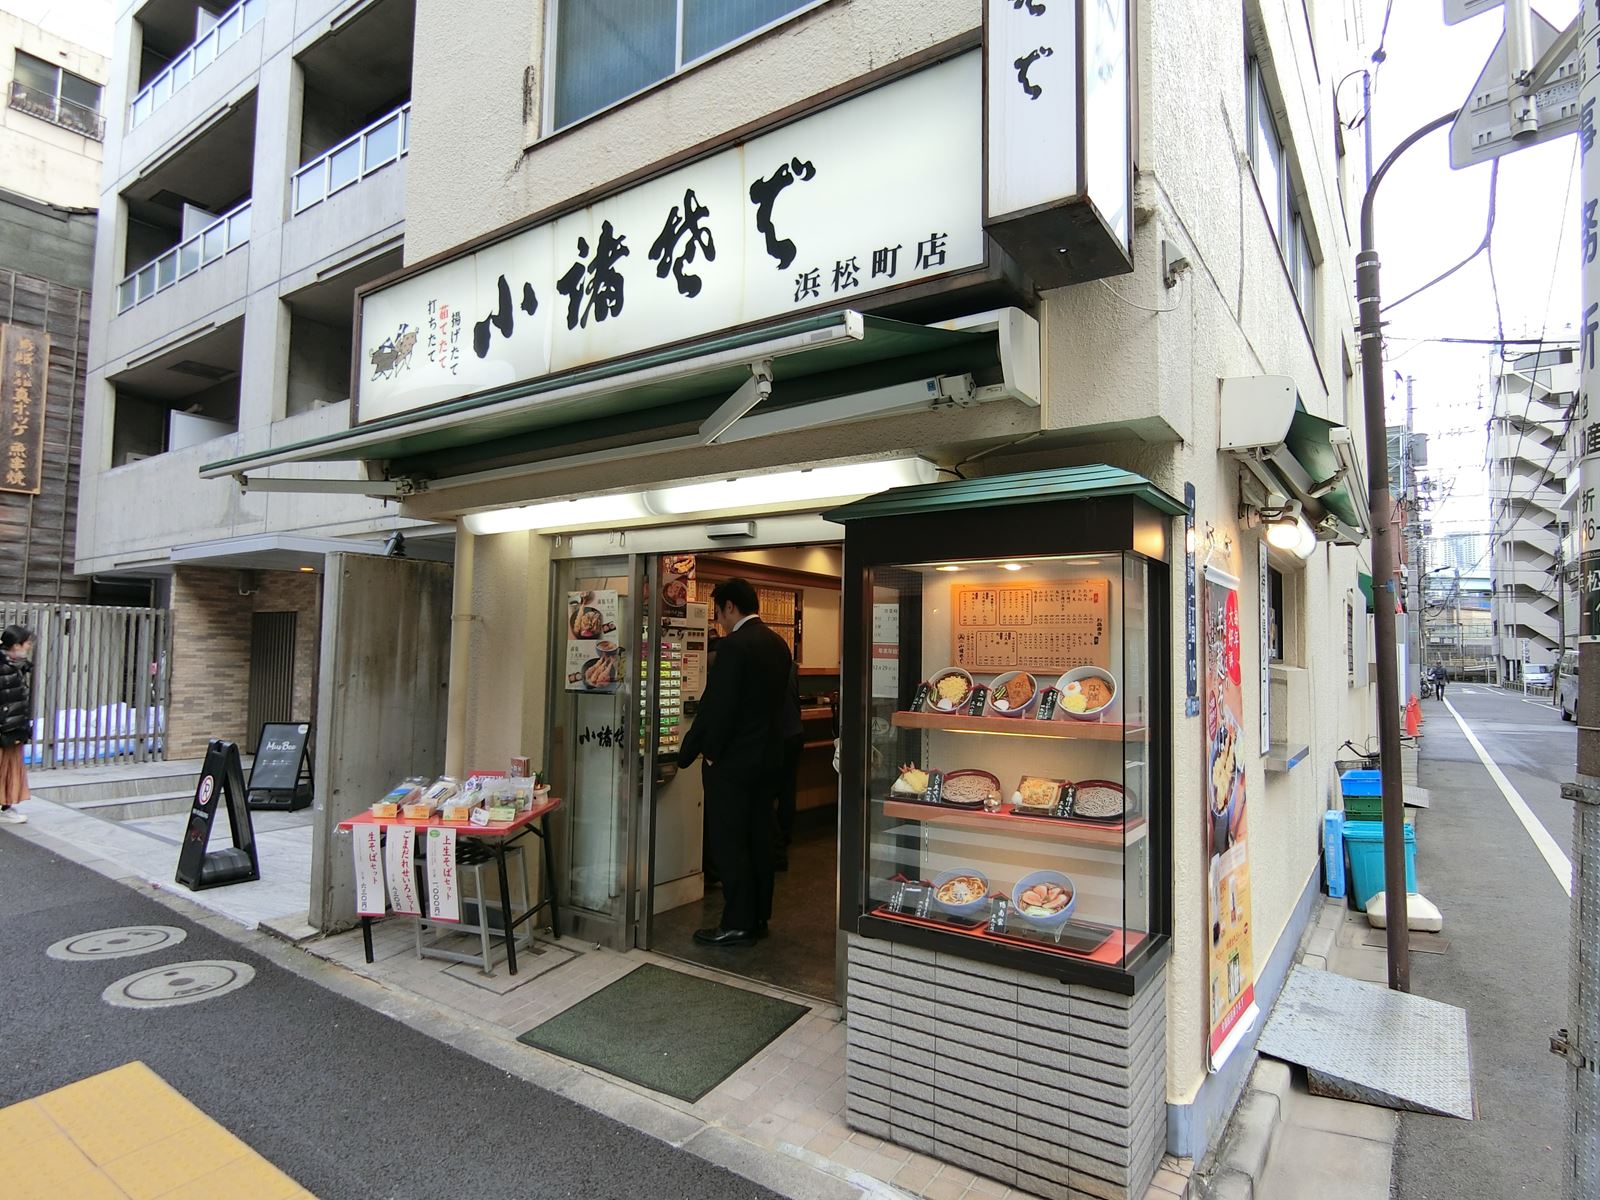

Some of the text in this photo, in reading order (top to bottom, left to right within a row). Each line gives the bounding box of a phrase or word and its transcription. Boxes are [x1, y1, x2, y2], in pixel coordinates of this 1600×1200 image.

[794, 232, 949, 303] 浜松町店
[427, 299, 437, 363] 打ちたて
[450, 310, 461, 376] 揚げたて
[368, 831, 379, 886] 生そばセット
[400, 829, 415, 912] ごまだれせいろセット
[442, 834, 452, 901] 上生そばセット
